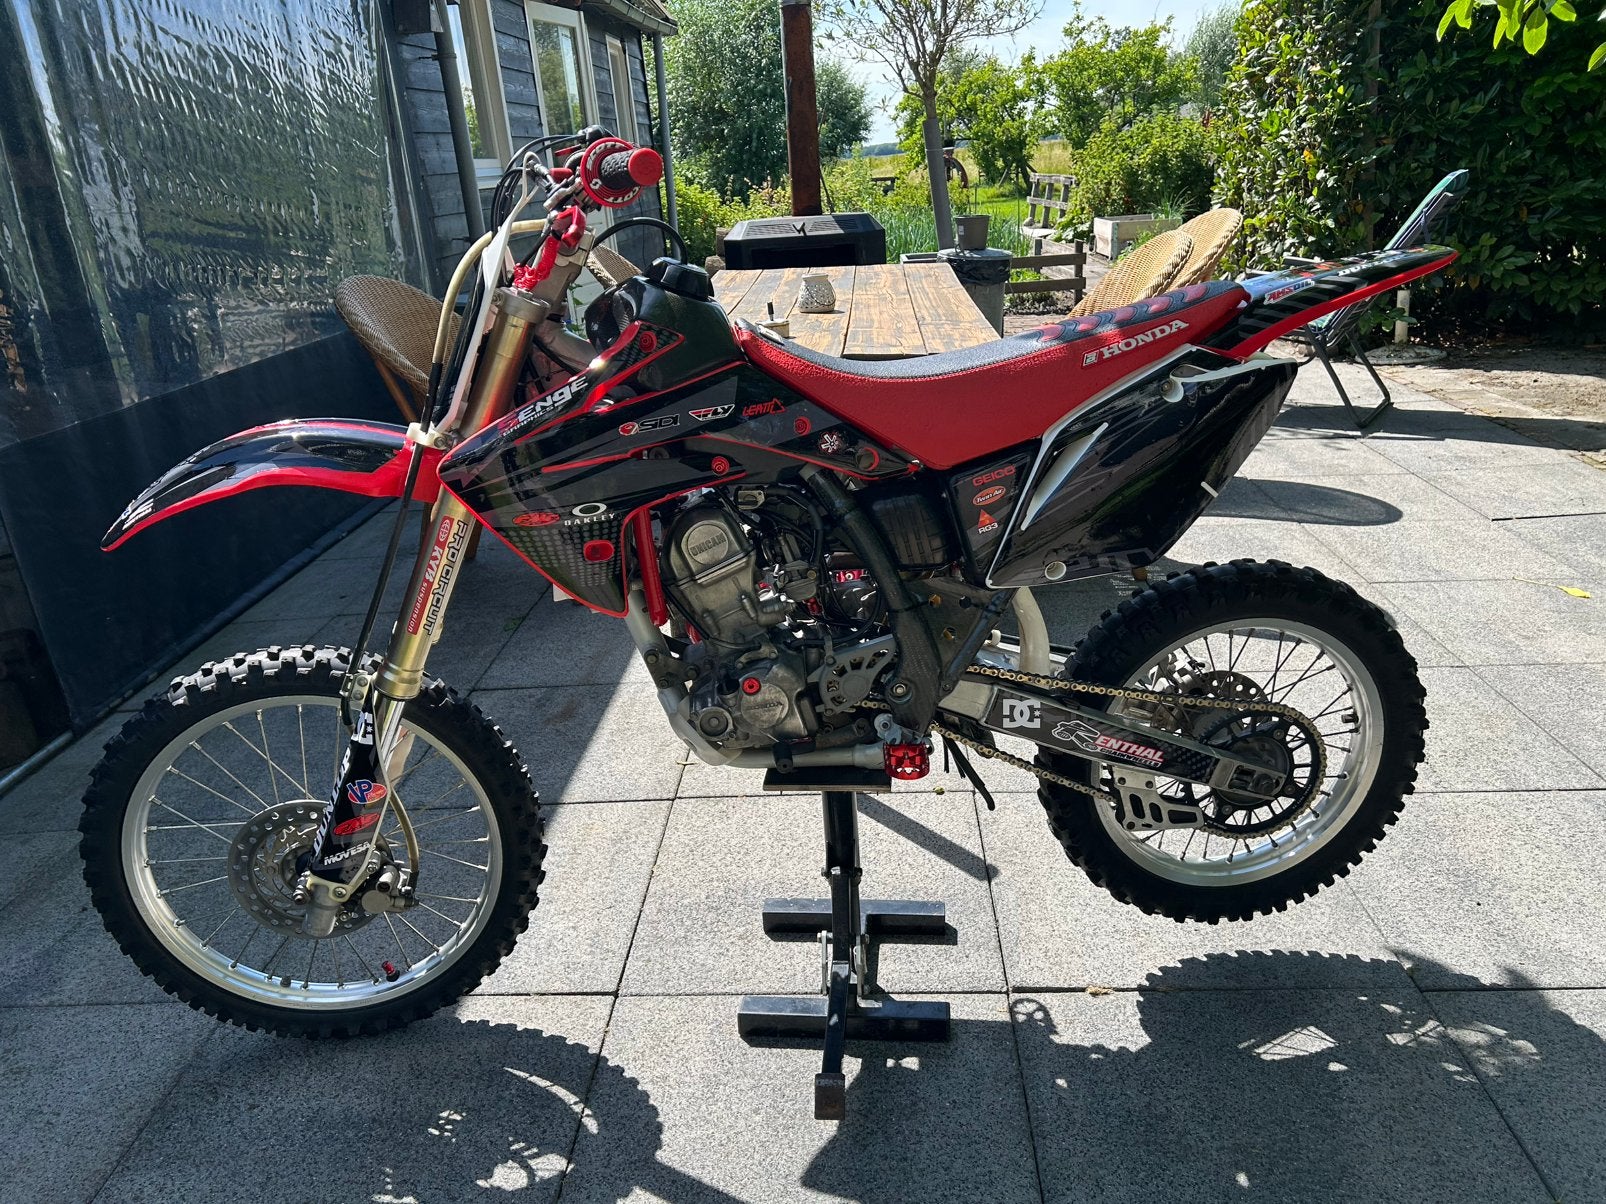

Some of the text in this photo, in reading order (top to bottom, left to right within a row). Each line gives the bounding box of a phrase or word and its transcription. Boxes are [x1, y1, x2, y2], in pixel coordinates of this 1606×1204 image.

[1266, 279, 1314, 302] AMSOIL
[1100, 319, 1190, 359] HONDA
[502, 406, 555, 437] GRAPHICS
[972, 464, 1017, 487] GEICO
[564, 513, 616, 526] OAKLEY
[978, 522, 999, 535] RG3
[689, 530, 727, 557] UNICAM
[407, 545, 443, 633] KYB suspension
[423, 519, 468, 636] PRO CIRCUIT
[1003, 698, 1041, 729] DC
[312, 746, 351, 858] DUNLOP
[346, 779, 373, 804] VP
